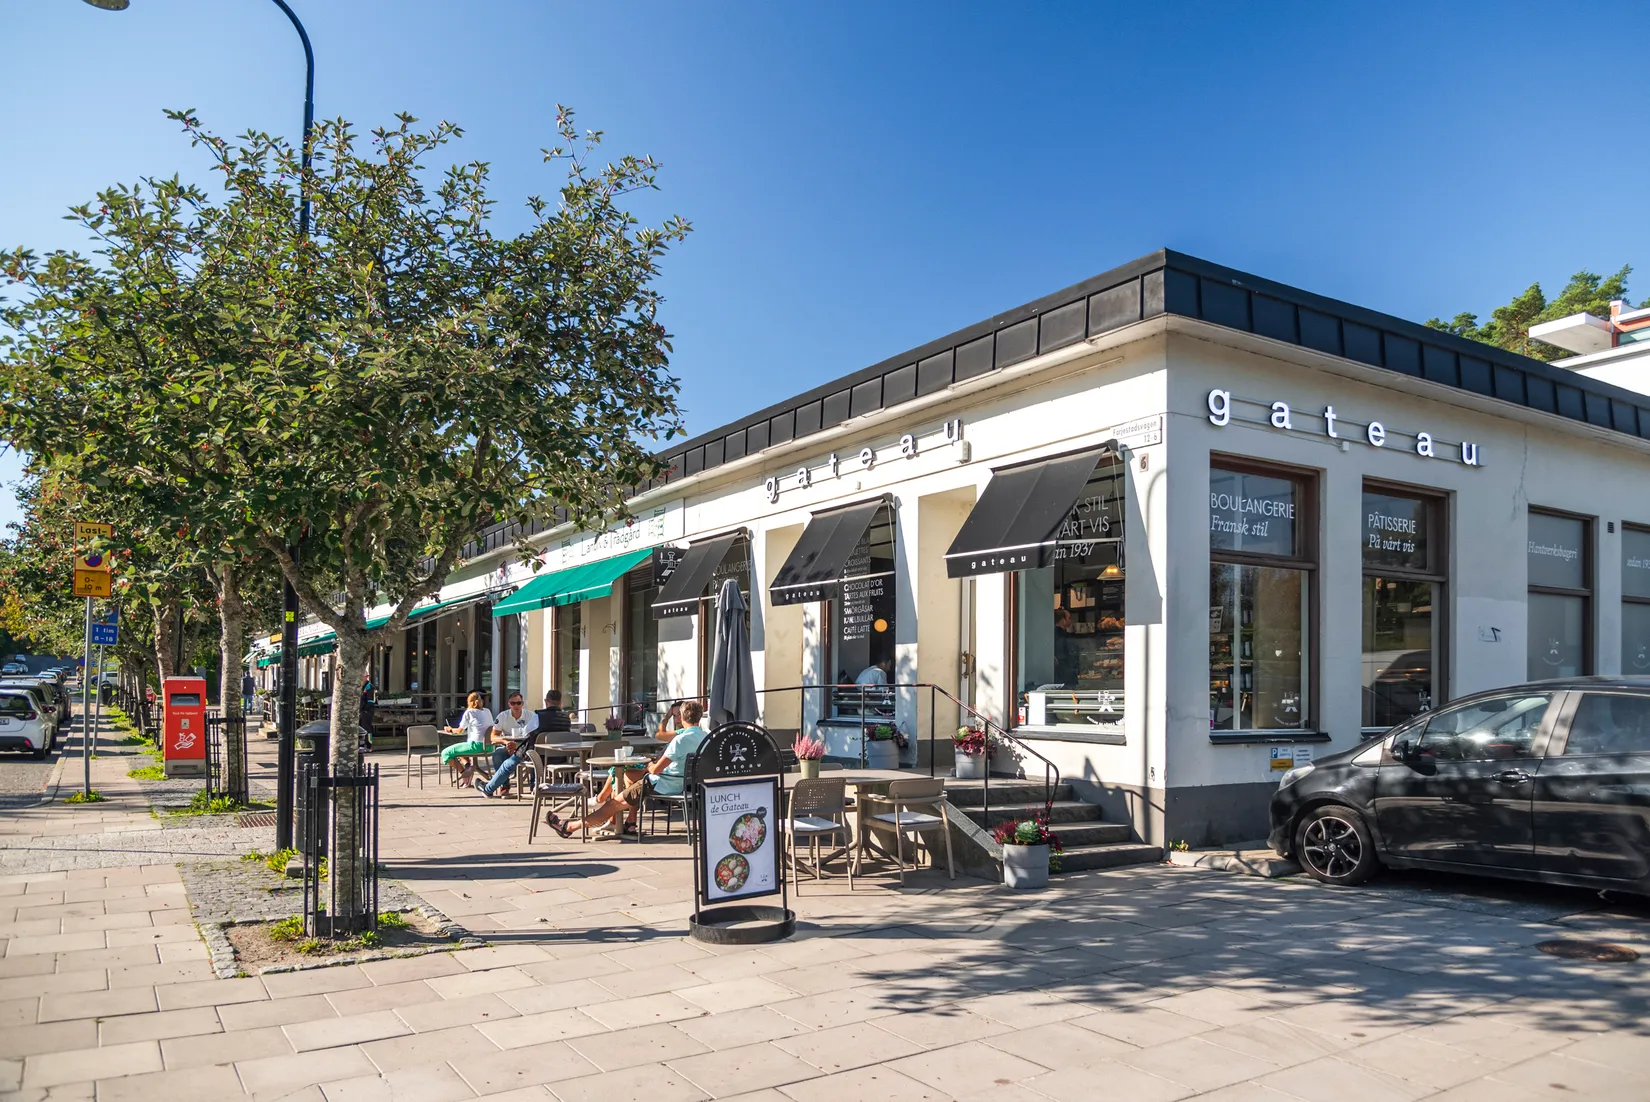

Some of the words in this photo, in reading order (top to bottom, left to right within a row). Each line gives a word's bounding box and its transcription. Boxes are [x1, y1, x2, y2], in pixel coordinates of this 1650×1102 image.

[1207, 388, 1479, 466] gateau
[766, 418, 963, 503] gateau
[1140, 456, 1147, 470] 6
[1084, 495, 1109, 513] STIL
[1210, 492, 1295, 519] BOULANGERIE
[80, 526, 107, 534] Last-
[1089, 515, 1110, 533] VIS
[1210, 514, 1249, 535] Fransk
[1251, 520, 1269, 537] stil
[1368, 511, 1416, 534] PÂTISSERIE
[1069, 542, 1096, 558] 1937
[1368, 534, 1381, 549] På
[1382, 537, 1401, 552] vårt
[1402, 540, 1415, 553] vis
[971, 555, 1026, 570] gateau
[843, 580, 870, 592] CHOCOLAT
[785, 590, 820, 601] gateau
[710, 792, 741, 804] LUNCH
[710, 805, 720, 813] de
[721, 803, 750, 812] Gateau
